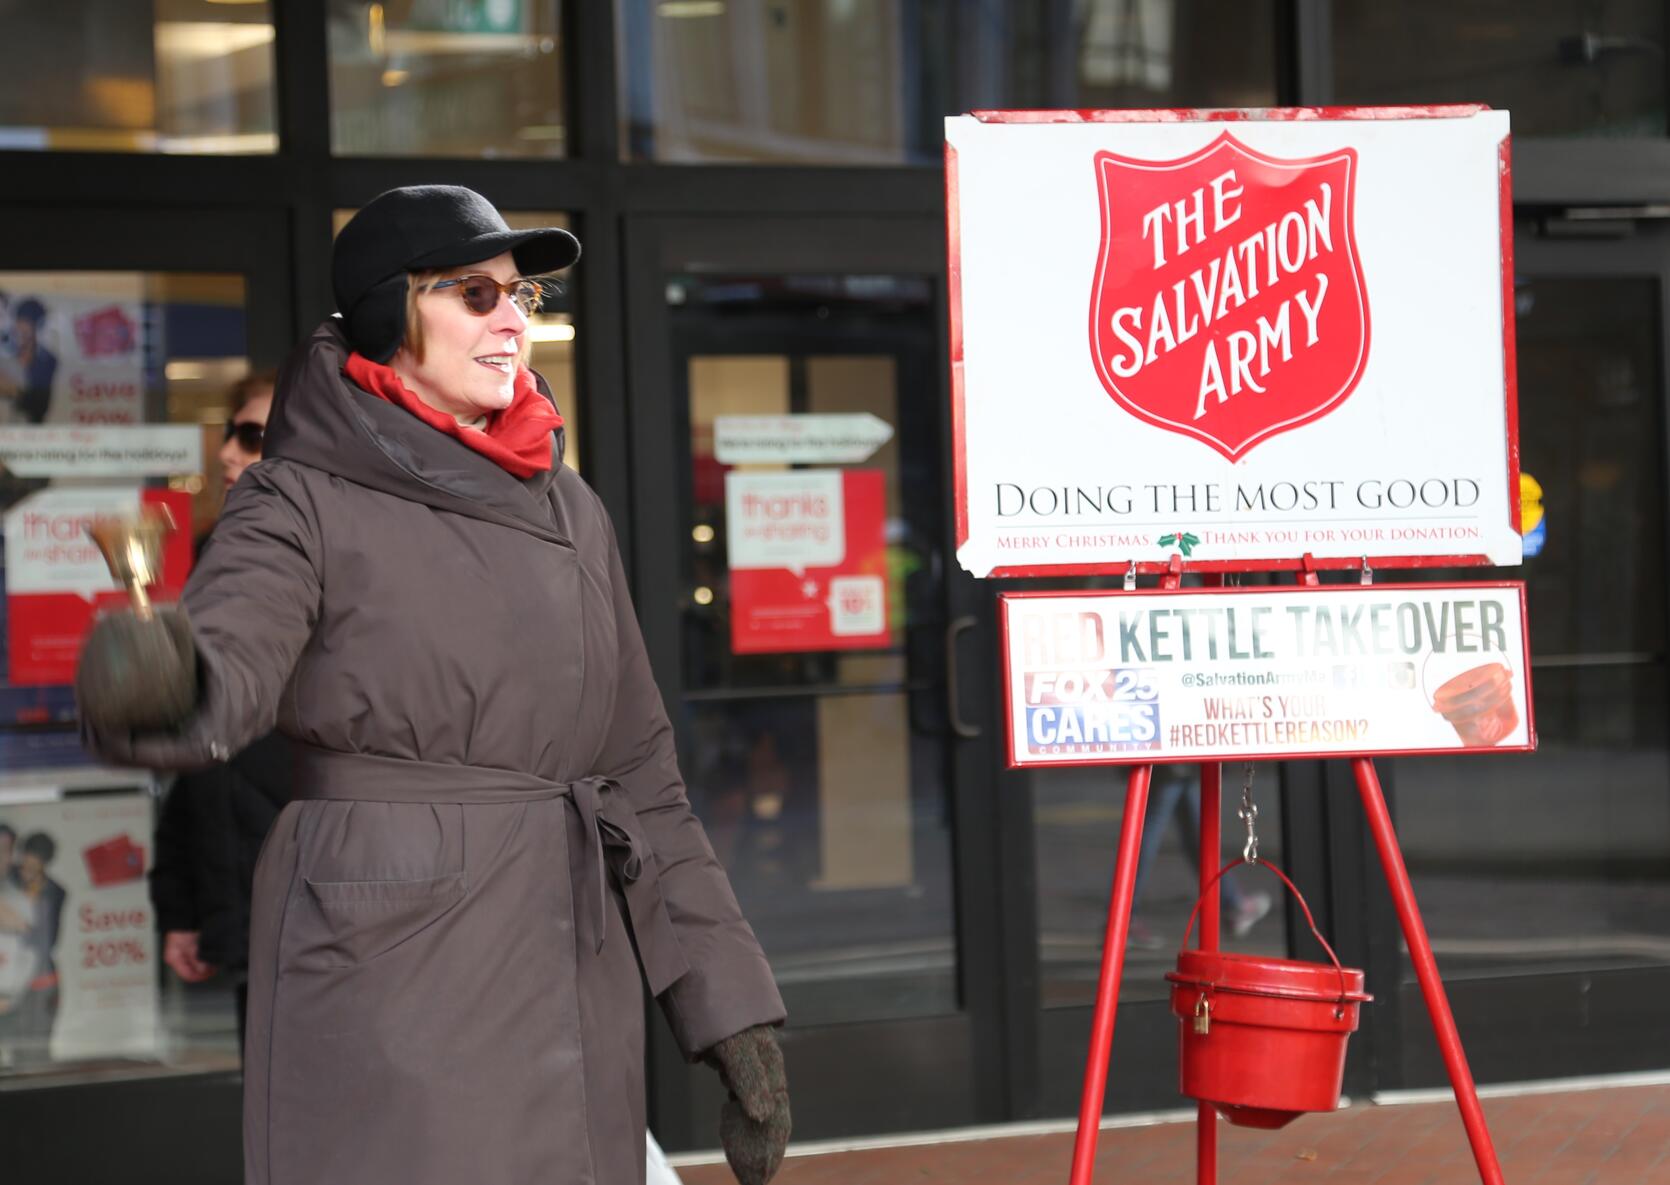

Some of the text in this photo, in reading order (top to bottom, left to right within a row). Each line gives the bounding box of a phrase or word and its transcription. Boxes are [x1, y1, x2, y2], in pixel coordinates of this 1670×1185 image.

[1142, 169, 1244, 270] THE
[1111, 182, 1333, 378] SALVATION
[1193, 272, 1329, 420] ARMY
[996, 478, 1480, 516] DOING THE MOST GOOD
[996, 534, 1050, 550] MERRY
[1202, 530, 1260, 545] THANK
[1265, 530, 1299, 544] YOU
[1305, 529, 1336, 542] FOR
[1340, 528, 1385, 542] YOUR
[1391, 525, 1484, 541] DONATION.
[1022, 599, 1508, 666] RED KETTLE TAKEOVER
[1030, 669, 1160, 704] FOX 25
[1031, 703, 1157, 746] CARES
[1203, 694, 1328, 722] WHAT'S YOUR
[1168, 718, 1370, 750] #REDKETTLEREASON?
